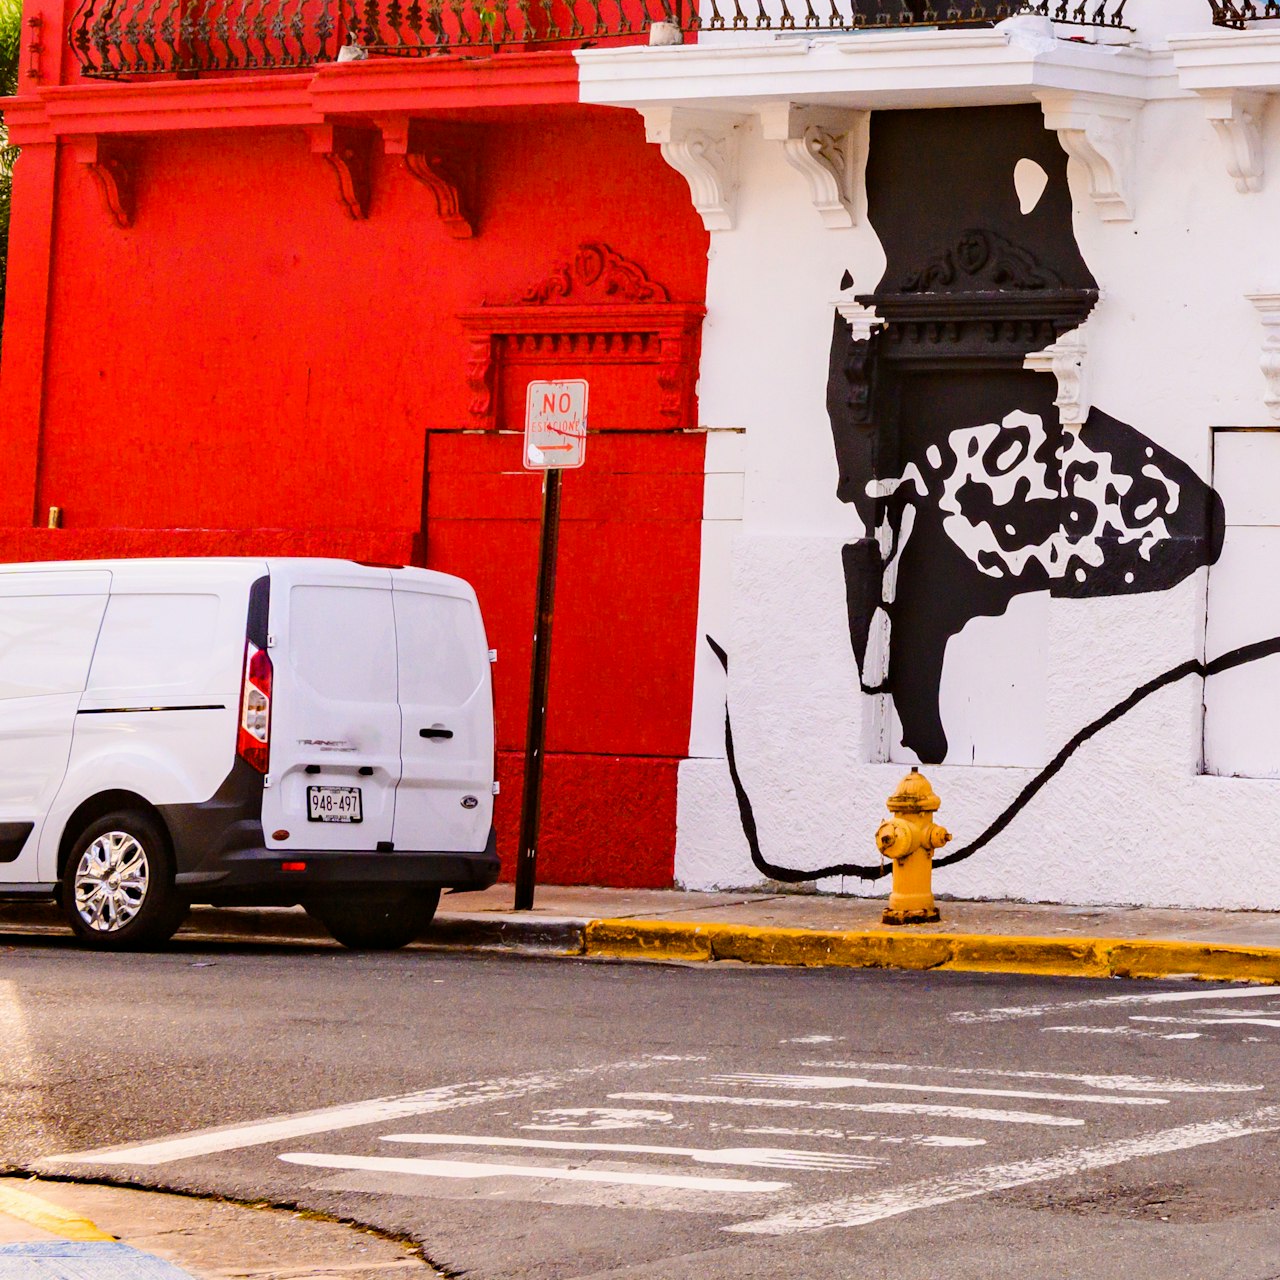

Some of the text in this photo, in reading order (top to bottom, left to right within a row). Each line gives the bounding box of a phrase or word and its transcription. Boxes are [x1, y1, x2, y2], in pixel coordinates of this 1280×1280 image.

[543, 393, 571, 414] NO
[532, 421, 580, 433] ESTACIONE
[312, 795, 357, 812] 948-497
